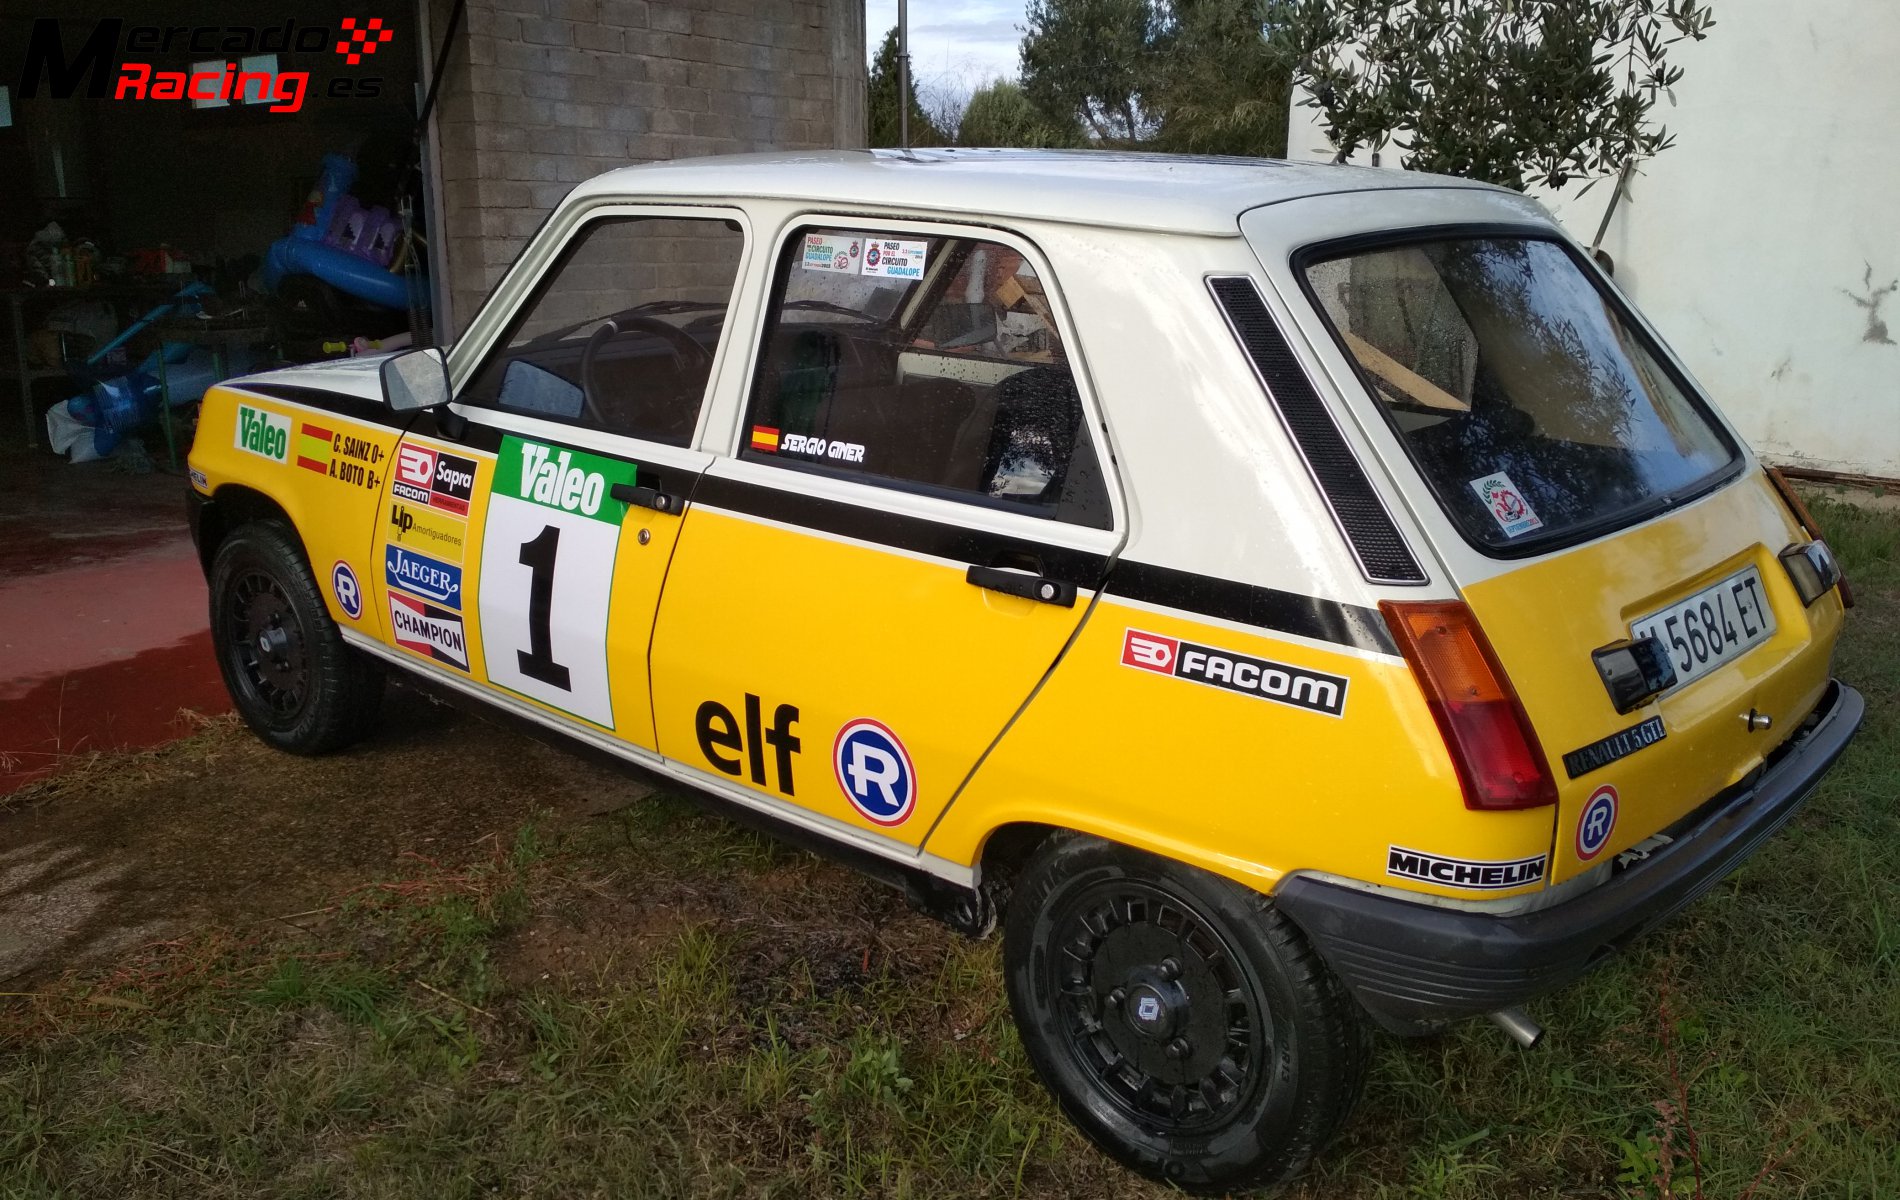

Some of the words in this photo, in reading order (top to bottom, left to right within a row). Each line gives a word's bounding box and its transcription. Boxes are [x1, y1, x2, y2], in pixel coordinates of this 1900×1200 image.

[807, 236, 823, 245] PASEO
[811, 245, 834, 254] CIRCUITO
[883, 241, 900, 250] PASEO
[805, 252, 833, 262] GUADALOPE
[881, 256, 908, 267] CIRCUITO
[887, 266, 921, 277] GUADALOPE
[239, 406, 287, 460] Valeo
[332, 433, 341, 454] C.
[343, 435, 371, 461] SAINZ
[780, 433, 827, 456] SERGIO
[827, 440, 865, 463] GINER
[329, 457, 338, 480] A.
[340, 458, 364, 487] BOTO
[366, 469, 381, 490] B+
[436, 460, 472, 492] Sapra
[520, 442, 605, 516] Valeo
[412, 523, 462, 547] Amortiguadores
[516, 524, 572, 693] 1
[1664, 593, 1738, 673] 5684
[1731, 576, 1767, 639] ET
[394, 609, 462, 652] CHAMPION
[695, 692, 801, 797] elf
[1567, 732, 1632, 776] RENAULT
[1631, 728, 1642, 749] 5
[1640, 718, 1667, 744] GTL
[1388, 851, 1546, 885] MICHELIN
